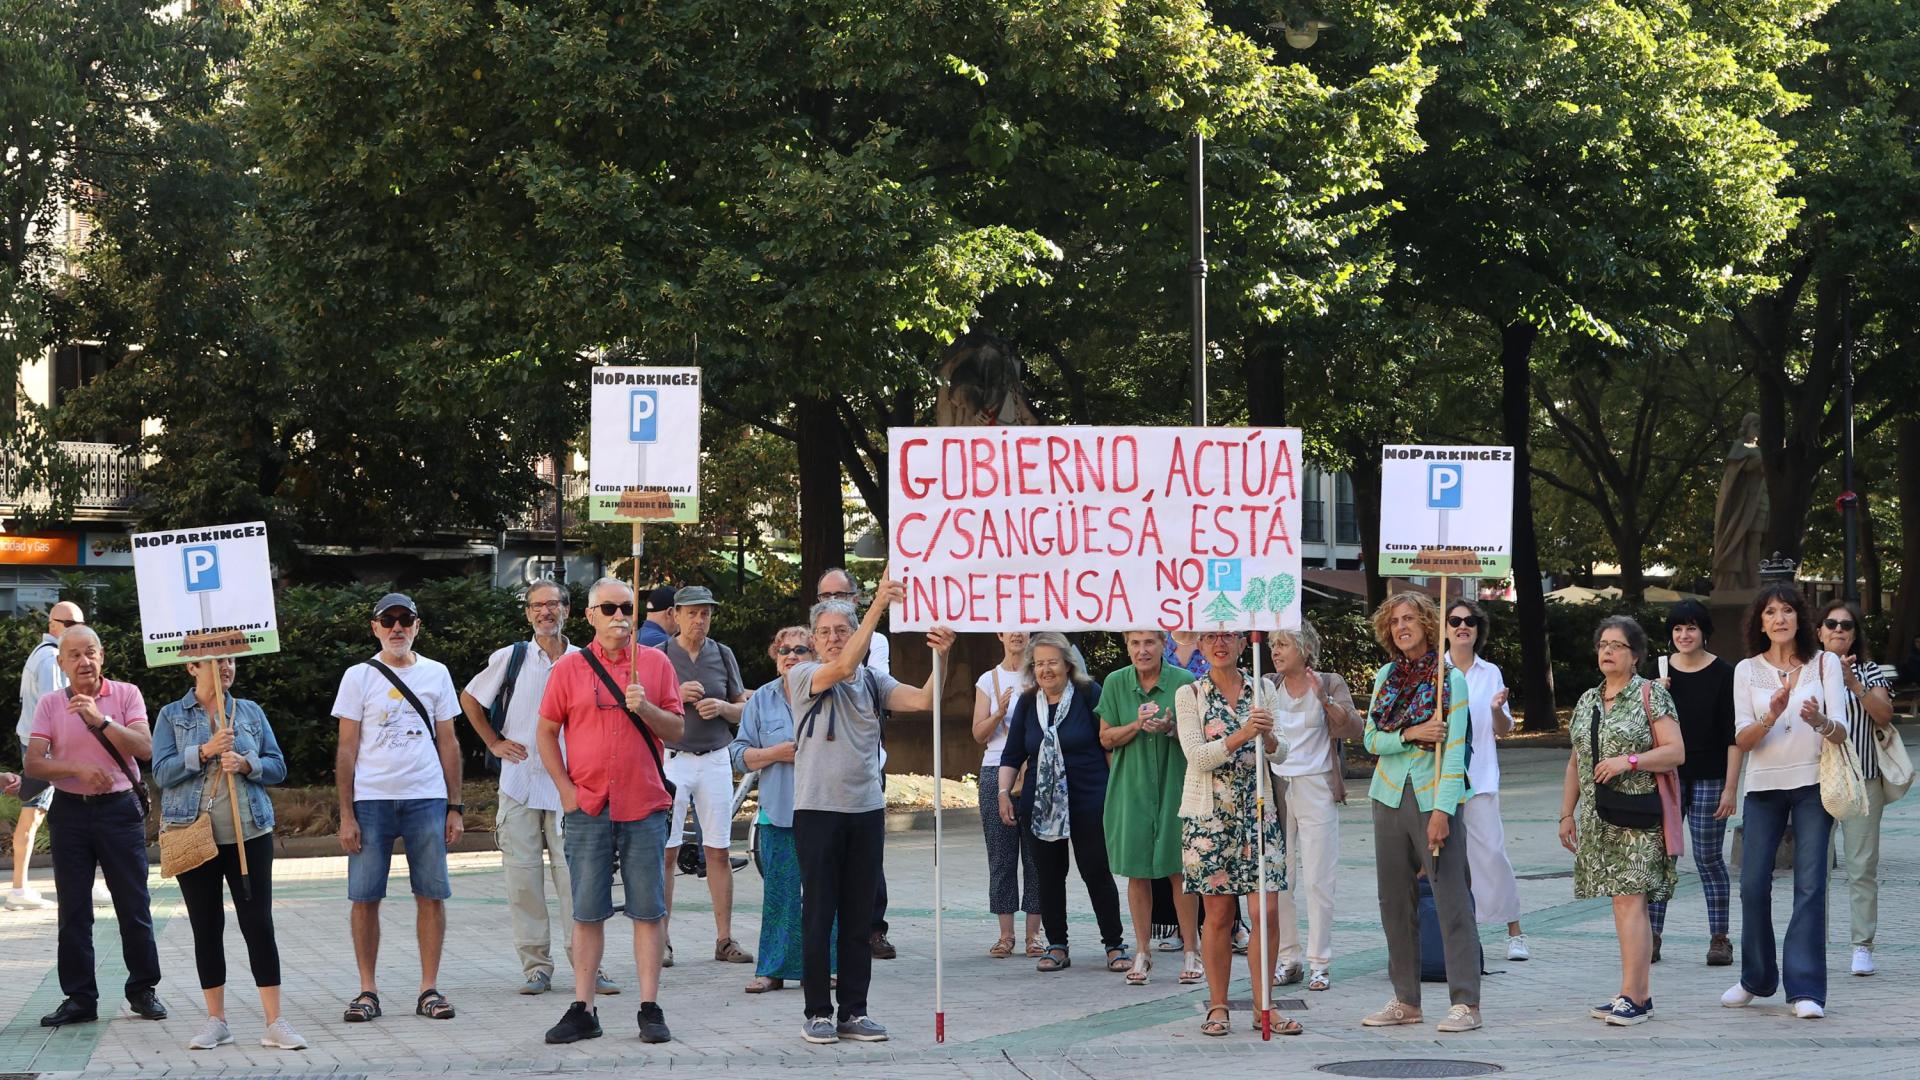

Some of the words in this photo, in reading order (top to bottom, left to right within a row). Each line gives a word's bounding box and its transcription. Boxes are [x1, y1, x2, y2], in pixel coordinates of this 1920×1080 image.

[632, 394, 655, 432] P
[1164, 430, 1297, 500] ACTÚA
[1432, 467, 1459, 500] P
[1190, 496, 1295, 557] ESTÁ
[34, 541, 50, 552] Gas
[187, 550, 214, 584] P
[1155, 557, 1204, 592] NO
[1214, 561, 1231, 588] P
[901, 566, 1134, 624] INDEFENSA
[1156, 592, 1200, 632] SÍ
